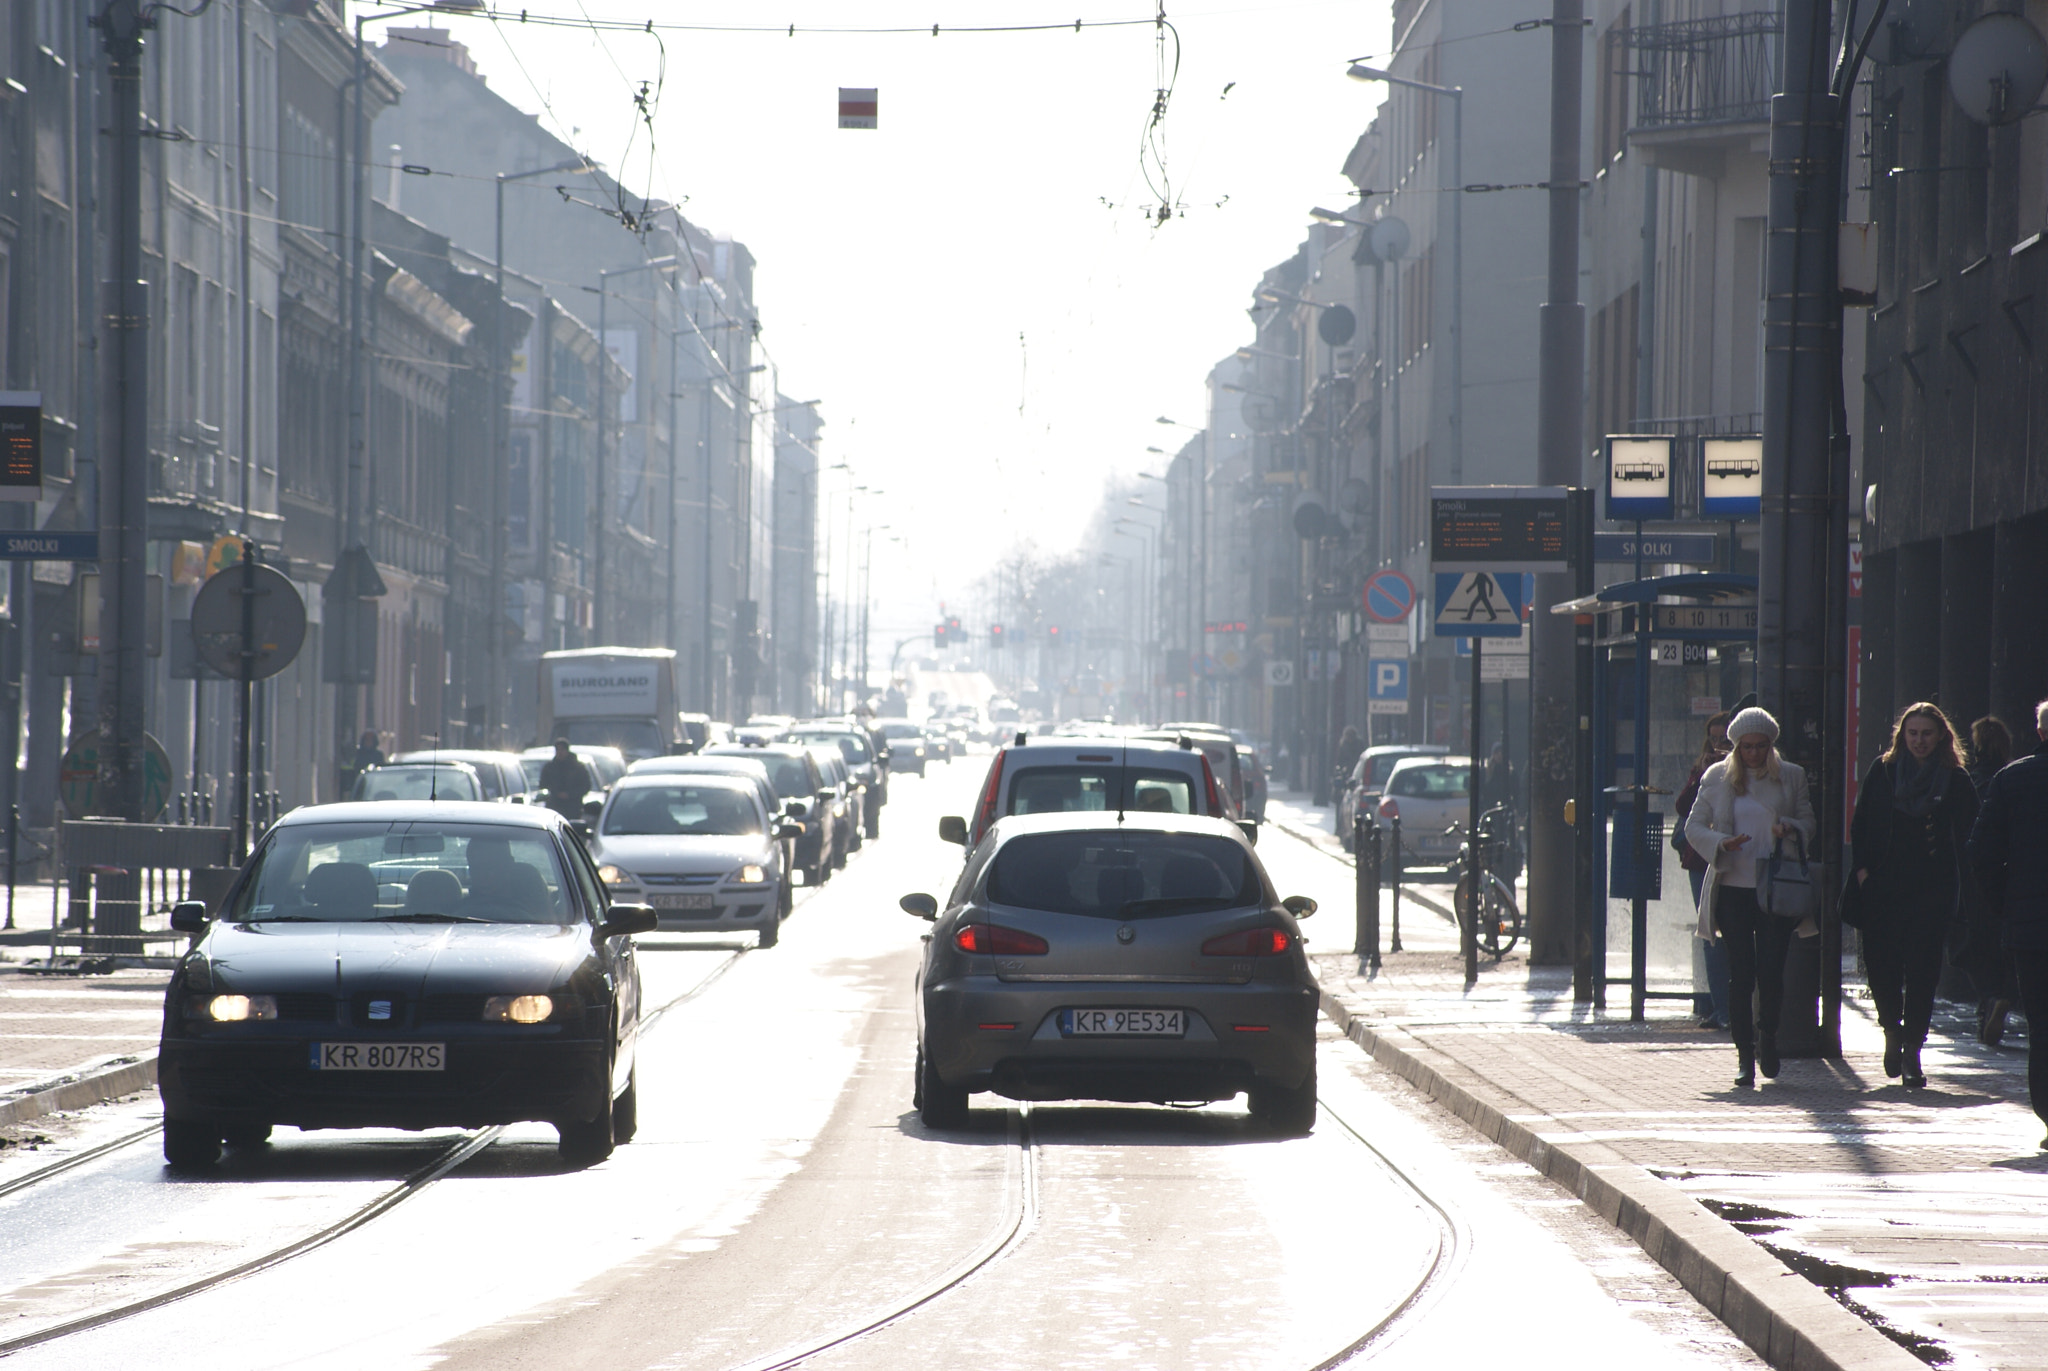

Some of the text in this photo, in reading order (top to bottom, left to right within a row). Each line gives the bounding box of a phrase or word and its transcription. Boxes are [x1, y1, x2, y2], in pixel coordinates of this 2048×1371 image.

[1437, 500, 1466, 511] Smolki
[8, 539, 58, 552] SMOLKI
[1668, 611, 1757, 627] 8 10 11 19
[1664, 645, 1706, 659] 23 904
[561, 676, 649, 688] BIUROLAND
[1377, 664, 1400, 695] P
[1076, 1011, 1180, 1033] KR 9E534
[325, 1045, 441, 1068] KR 807RS
